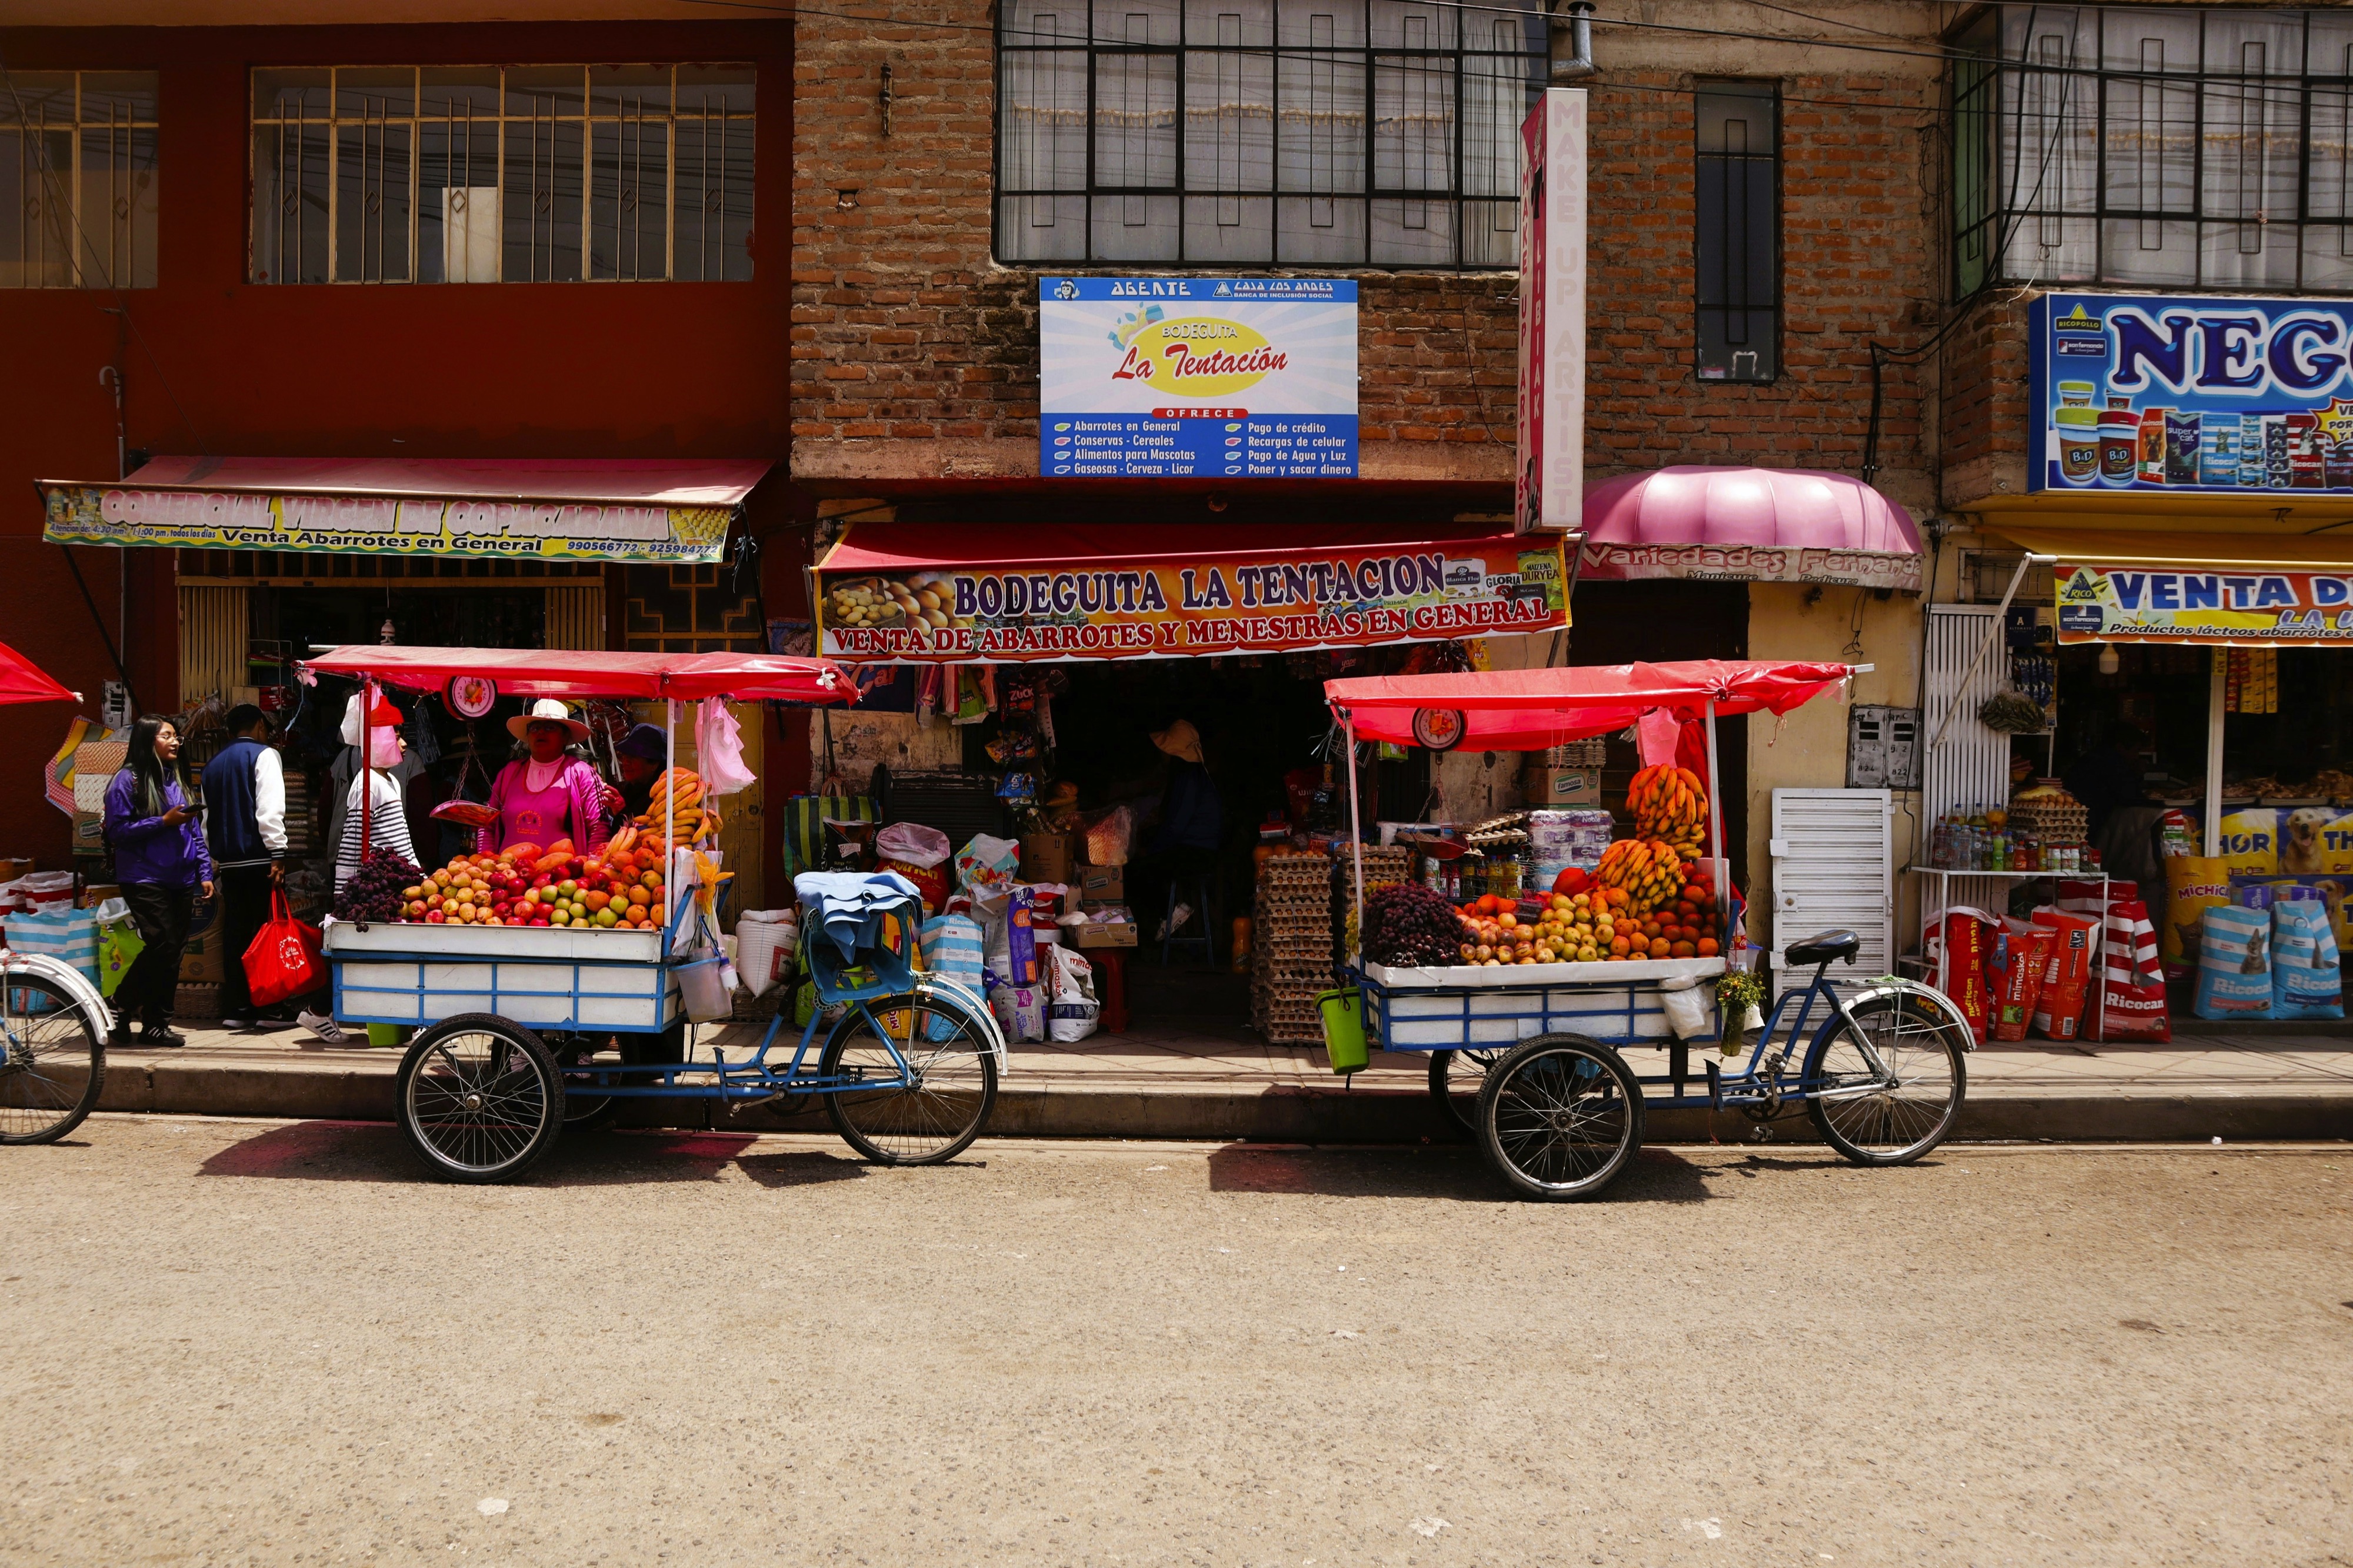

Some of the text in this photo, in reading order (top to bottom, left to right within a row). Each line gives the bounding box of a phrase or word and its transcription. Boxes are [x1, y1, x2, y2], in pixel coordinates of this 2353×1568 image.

[1521, 167, 1529, 276] MAKE
[1111, 282, 1191, 296] AGENTE
[1269, 282, 1291, 291] LOS
[1295, 282, 1334, 291] ANDES
[1552, 101, 1581, 516] MAKE UP ARTIST
[1162, 323, 1238, 339] BODEGUITA
[2108, 310, 2353, 393] NEG
[1112, 343, 1288, 380] La Tentación
[1166, 409, 1234, 418] OFRECE
[1074, 421, 1122, 431] Abarrotes
[1142, 421, 1180, 431] General
[1248, 422, 1326, 435] Pago de crédito
[2167, 426, 2191, 435] super
[1074, 435, 1124, 446] Conservas
[1132, 435, 1174, 446] Cereales
[1248, 436, 1346, 448] Recargas de celular
[1518, 366, 1527, 528] ARTIST
[1074, 449, 1195, 462] Alimentos para Mascotas
[1248, 450, 1347, 462] Pago de Agua y Luz
[2072, 451, 2092, 462] B&D
[2109, 450, 2127, 461] B&D
[2204, 456, 2238, 465] Ricocat
[1074, 462, 1117, 474] Gaseosas
[1126, 463, 1162, 474] Cerveza
[1172, 463, 1194, 474] Licor
[1248, 464, 1276, 474] Poner
[1279, 466, 1286, 476] y
[1321, 464, 1351, 475] dinero
[101, 490, 671, 542] COMERCIAL VIRGEN DE COPACABANA
[93, 525, 111, 534] 4:30
[171, 529, 189, 538] todos
[189, 530, 201, 538] los
[201, 529, 216, 539] dias
[222, 530, 542, 551] Venta Abarrotes en General
[566, 541, 638, 553] 990566772
[649, 543, 718, 555] 925984772
[1527, 562, 1552, 571] MAIZENA
[1579, 542, 1921, 578] Variedades Fernanda
[1445, 574, 1480, 583] Blanca Flor
[1486, 574, 1521, 588] GLORIA
[1522, 569, 1560, 582] DURYEA
[1685, 570, 1759, 581] Manicure
[1799, 573, 1859, 585] Pedicure
[954, 552, 1445, 617] BODEGUITA LA TENTACION
[2110, 572, 2295, 609] VENTA
[2070, 589, 2092, 598] RICO
[831, 598, 1551, 652] VENTA DE ABARROTES Y MENESTRAS EN GENERAL
[2279, 609, 2324, 629] LA
[2109, 623, 2194, 635] Productos
[2197, 625, 2257, 637] lácteos
[2259, 627, 2344, 638] abarrotes
[1340, 657, 1357, 672] yape
[1558, 778, 1581, 790] famosa
[948, 917, 975, 926] Ricocat
[2069, 932, 2081, 948] CAN
[2012, 951, 2025, 1002] mimaskot
[1964, 978, 1975, 1017] nutrican
[2105, 992, 2164, 1010] Ricocan
[1015, 1018, 1024, 1039] super
